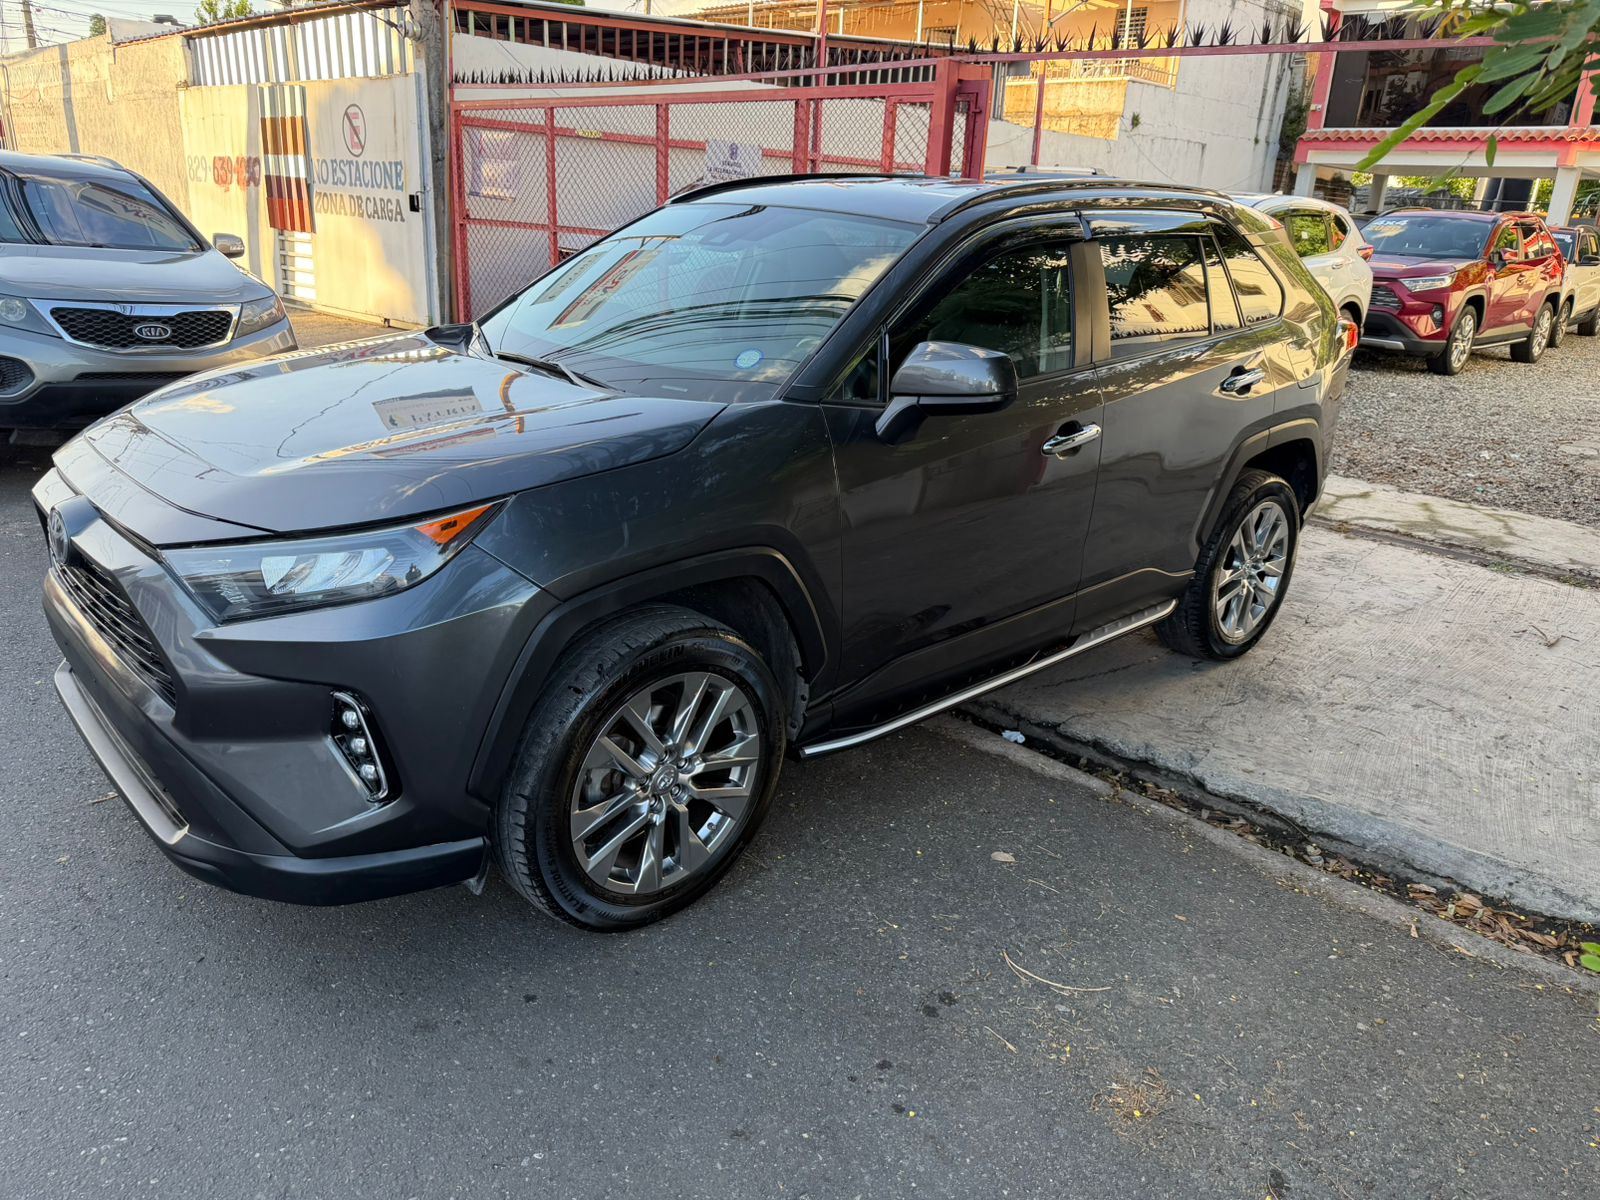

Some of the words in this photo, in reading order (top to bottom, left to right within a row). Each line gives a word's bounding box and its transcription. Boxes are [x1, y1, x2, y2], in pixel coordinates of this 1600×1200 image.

[312, 158, 329, 185] NO
[331, 158, 404, 192] ESTACIONE
[314, 190, 347, 217] ZONA
[348, 193, 365, 219] DE
[365, 196, 405, 222] CARGA
[141, 327, 165, 336] KIA
